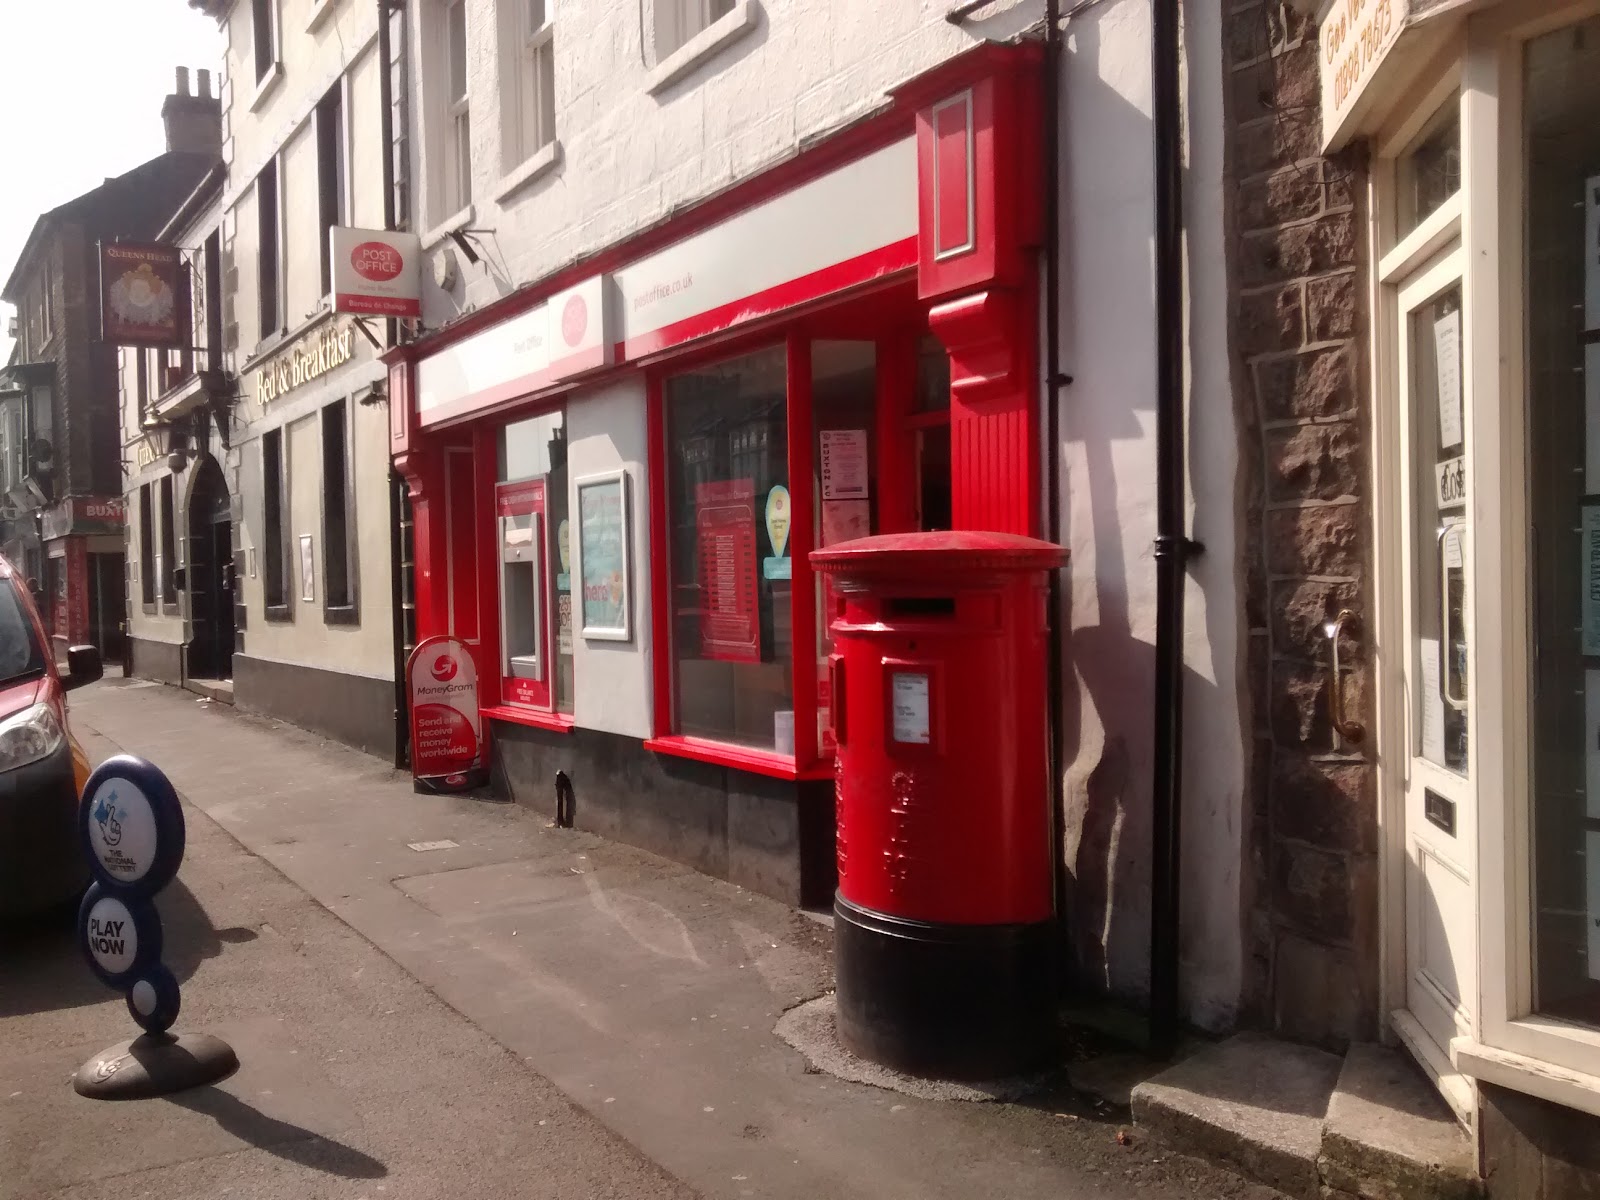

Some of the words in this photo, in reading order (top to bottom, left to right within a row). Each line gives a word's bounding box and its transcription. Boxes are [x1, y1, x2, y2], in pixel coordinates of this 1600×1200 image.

[1326, 11, 1346, 65] Gee
[1334, 41, 1360, 111] 01298
[107, 248, 145, 259] QUEENS
[362, 249, 392, 260] POST
[355, 260, 397, 273] OFFICE
[633, 271, 693, 312] postoffice.co.uk
[348, 299, 372, 308] Bureau
[256, 360, 277, 406] Bed
[278, 367, 289, 395] &
[292, 328, 351, 387] Breakfast
[822, 443, 831, 481] BUXTON
[824, 485, 831, 497] FC
[417, 683, 473, 696] MoneyGram
[418, 716, 443, 727] Send
[444, 714, 462, 725] and
[419, 727, 453, 738] receive
[420, 738, 452, 748] money
[420, 747, 468, 759] worldwide
[109, 849, 123, 858] THE
[104, 857, 136, 865] NATIONAL
[91, 919, 125, 938] PLAY
[91, 937, 125, 955] NOW
